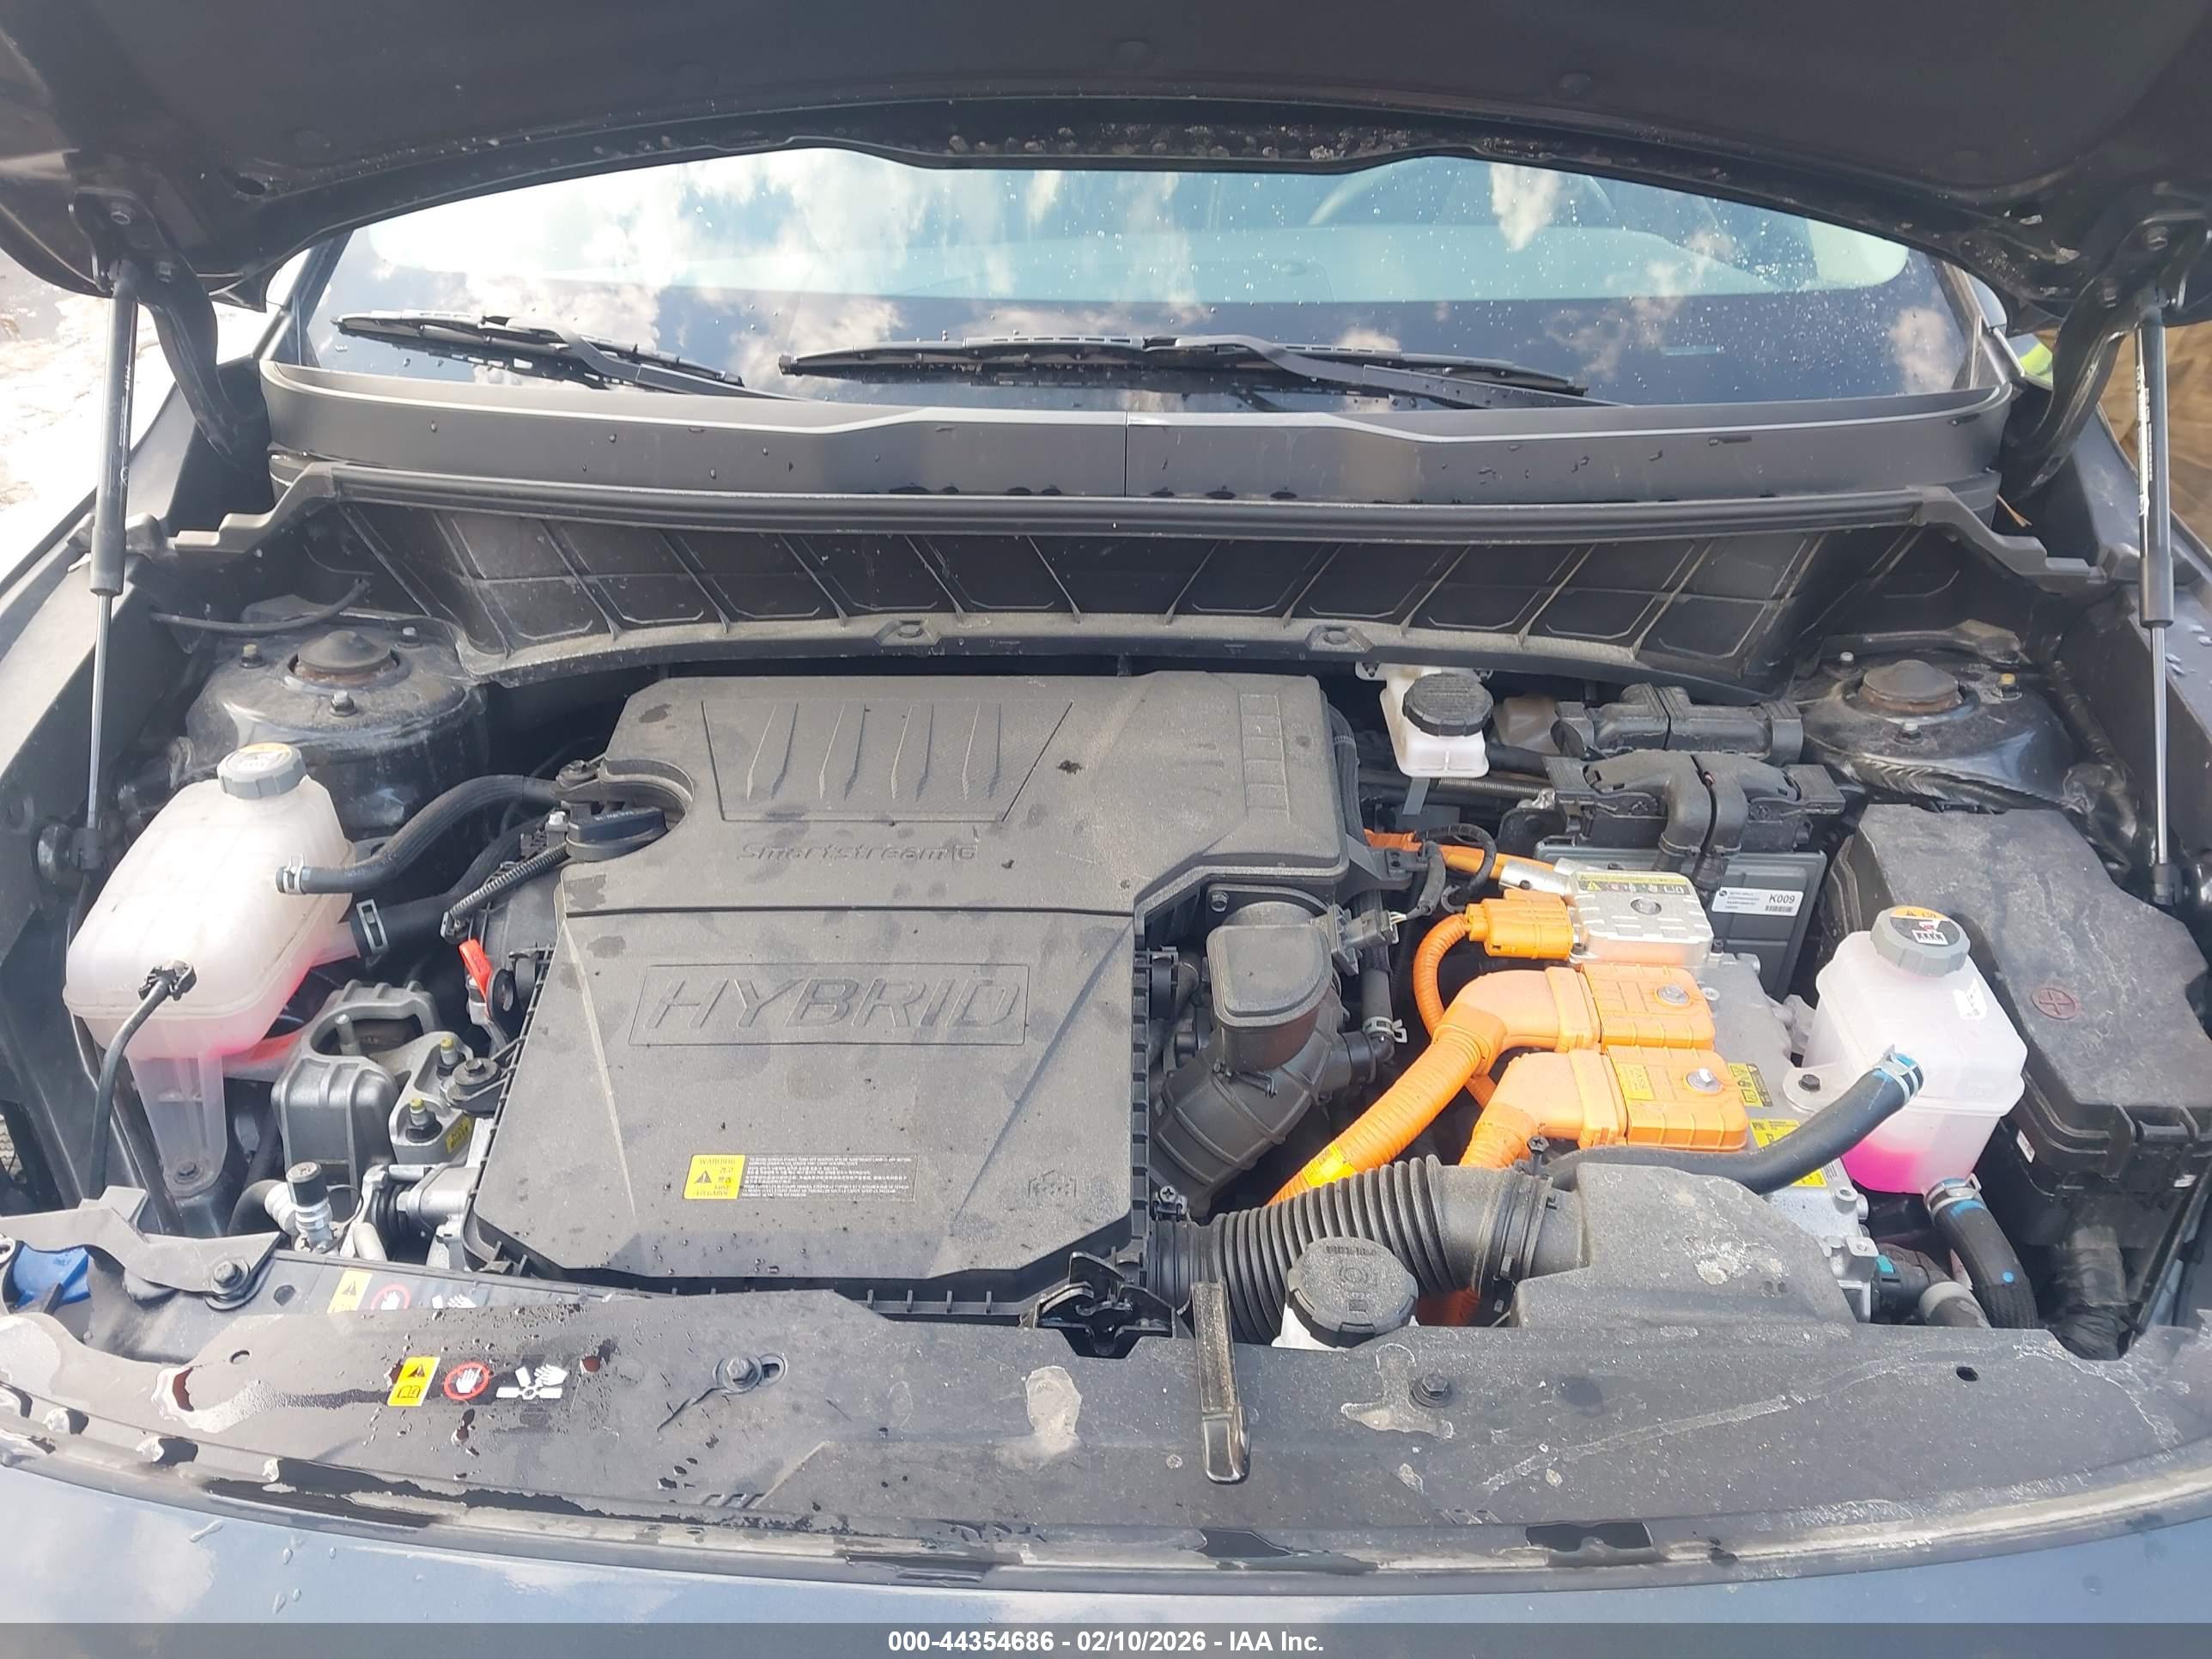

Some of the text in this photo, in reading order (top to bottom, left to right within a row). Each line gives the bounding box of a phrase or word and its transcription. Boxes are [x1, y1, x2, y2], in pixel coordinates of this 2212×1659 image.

[737, 844, 948, 860] Smartstream
[1769, 894, 1796, 904] K009
[642, 977, 1020, 1029] HYBRID
